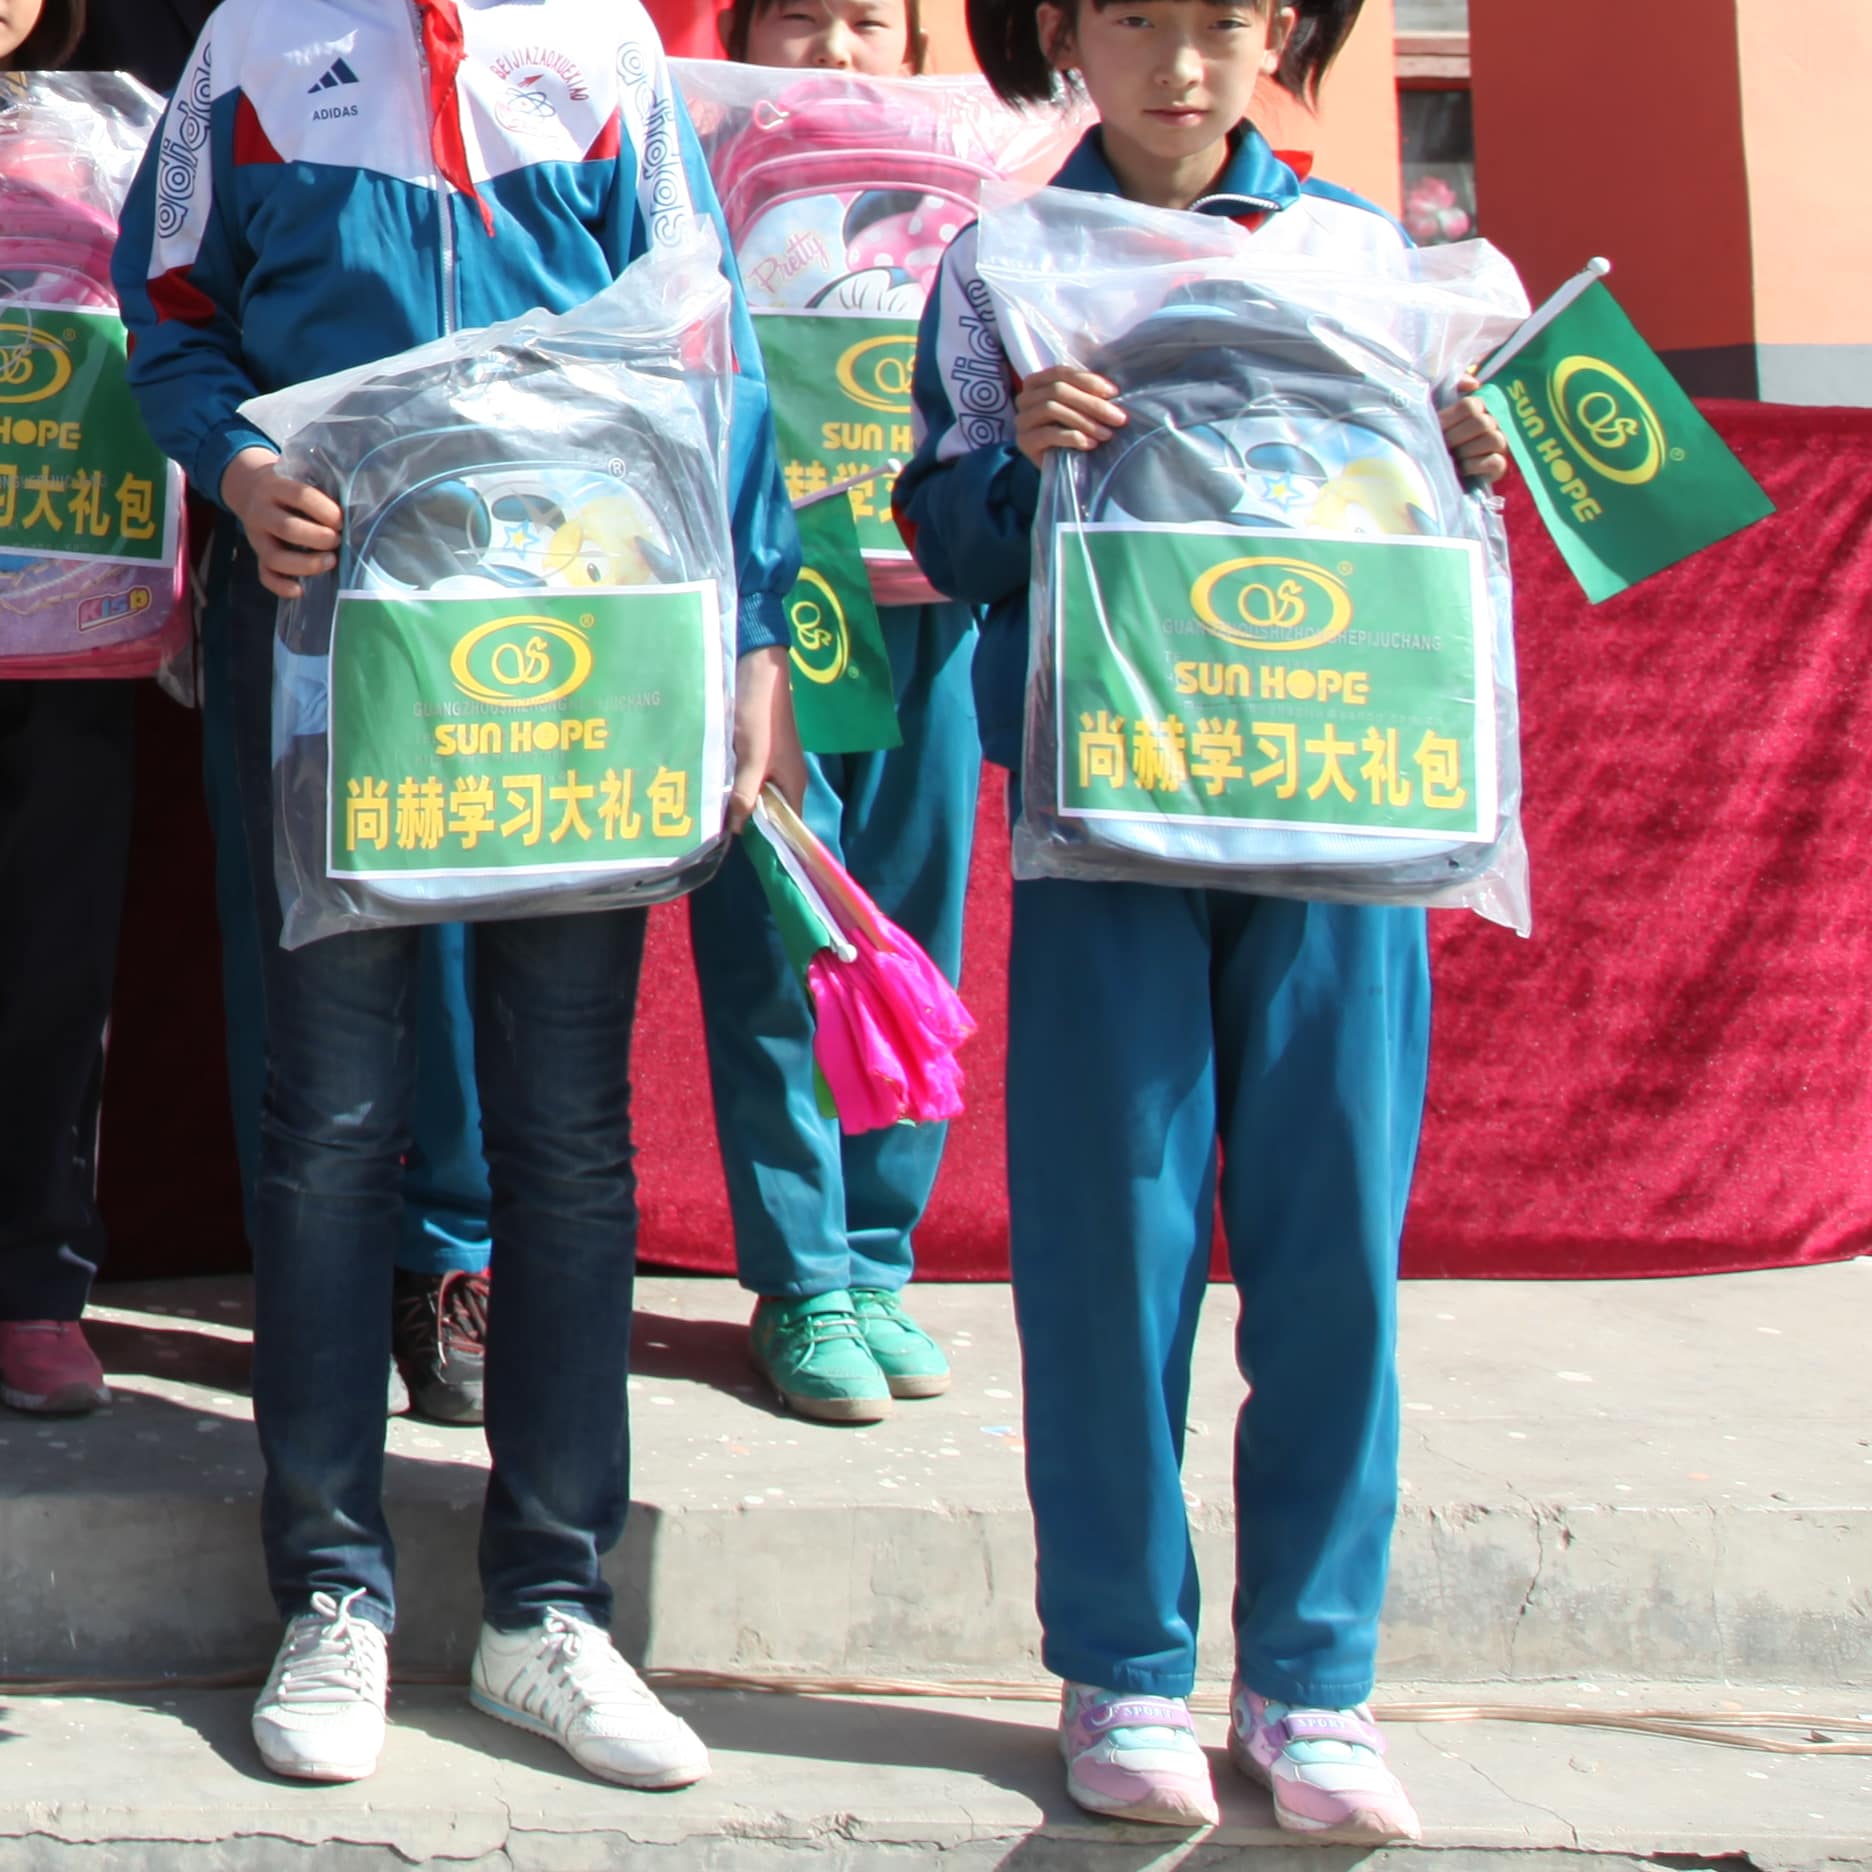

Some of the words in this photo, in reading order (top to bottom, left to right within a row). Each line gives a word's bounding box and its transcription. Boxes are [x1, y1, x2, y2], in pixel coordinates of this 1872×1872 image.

[312, 104, 359, 123] ADIDAS
[822, 422, 885, 451] SUN
[1507, 380, 1547, 439] SUN
[1536, 438, 1603, 524] HOPE
[1173, 660, 1253, 698] SUN
[1260, 665, 1371, 705] HOPE
[435, 722, 503, 757] SUN
[510, 717, 609, 755] HOPE
[1078, 709, 1467, 810] 尚赫学习大礼包
[345, 766, 694, 852] 尚赫学习大礼包
